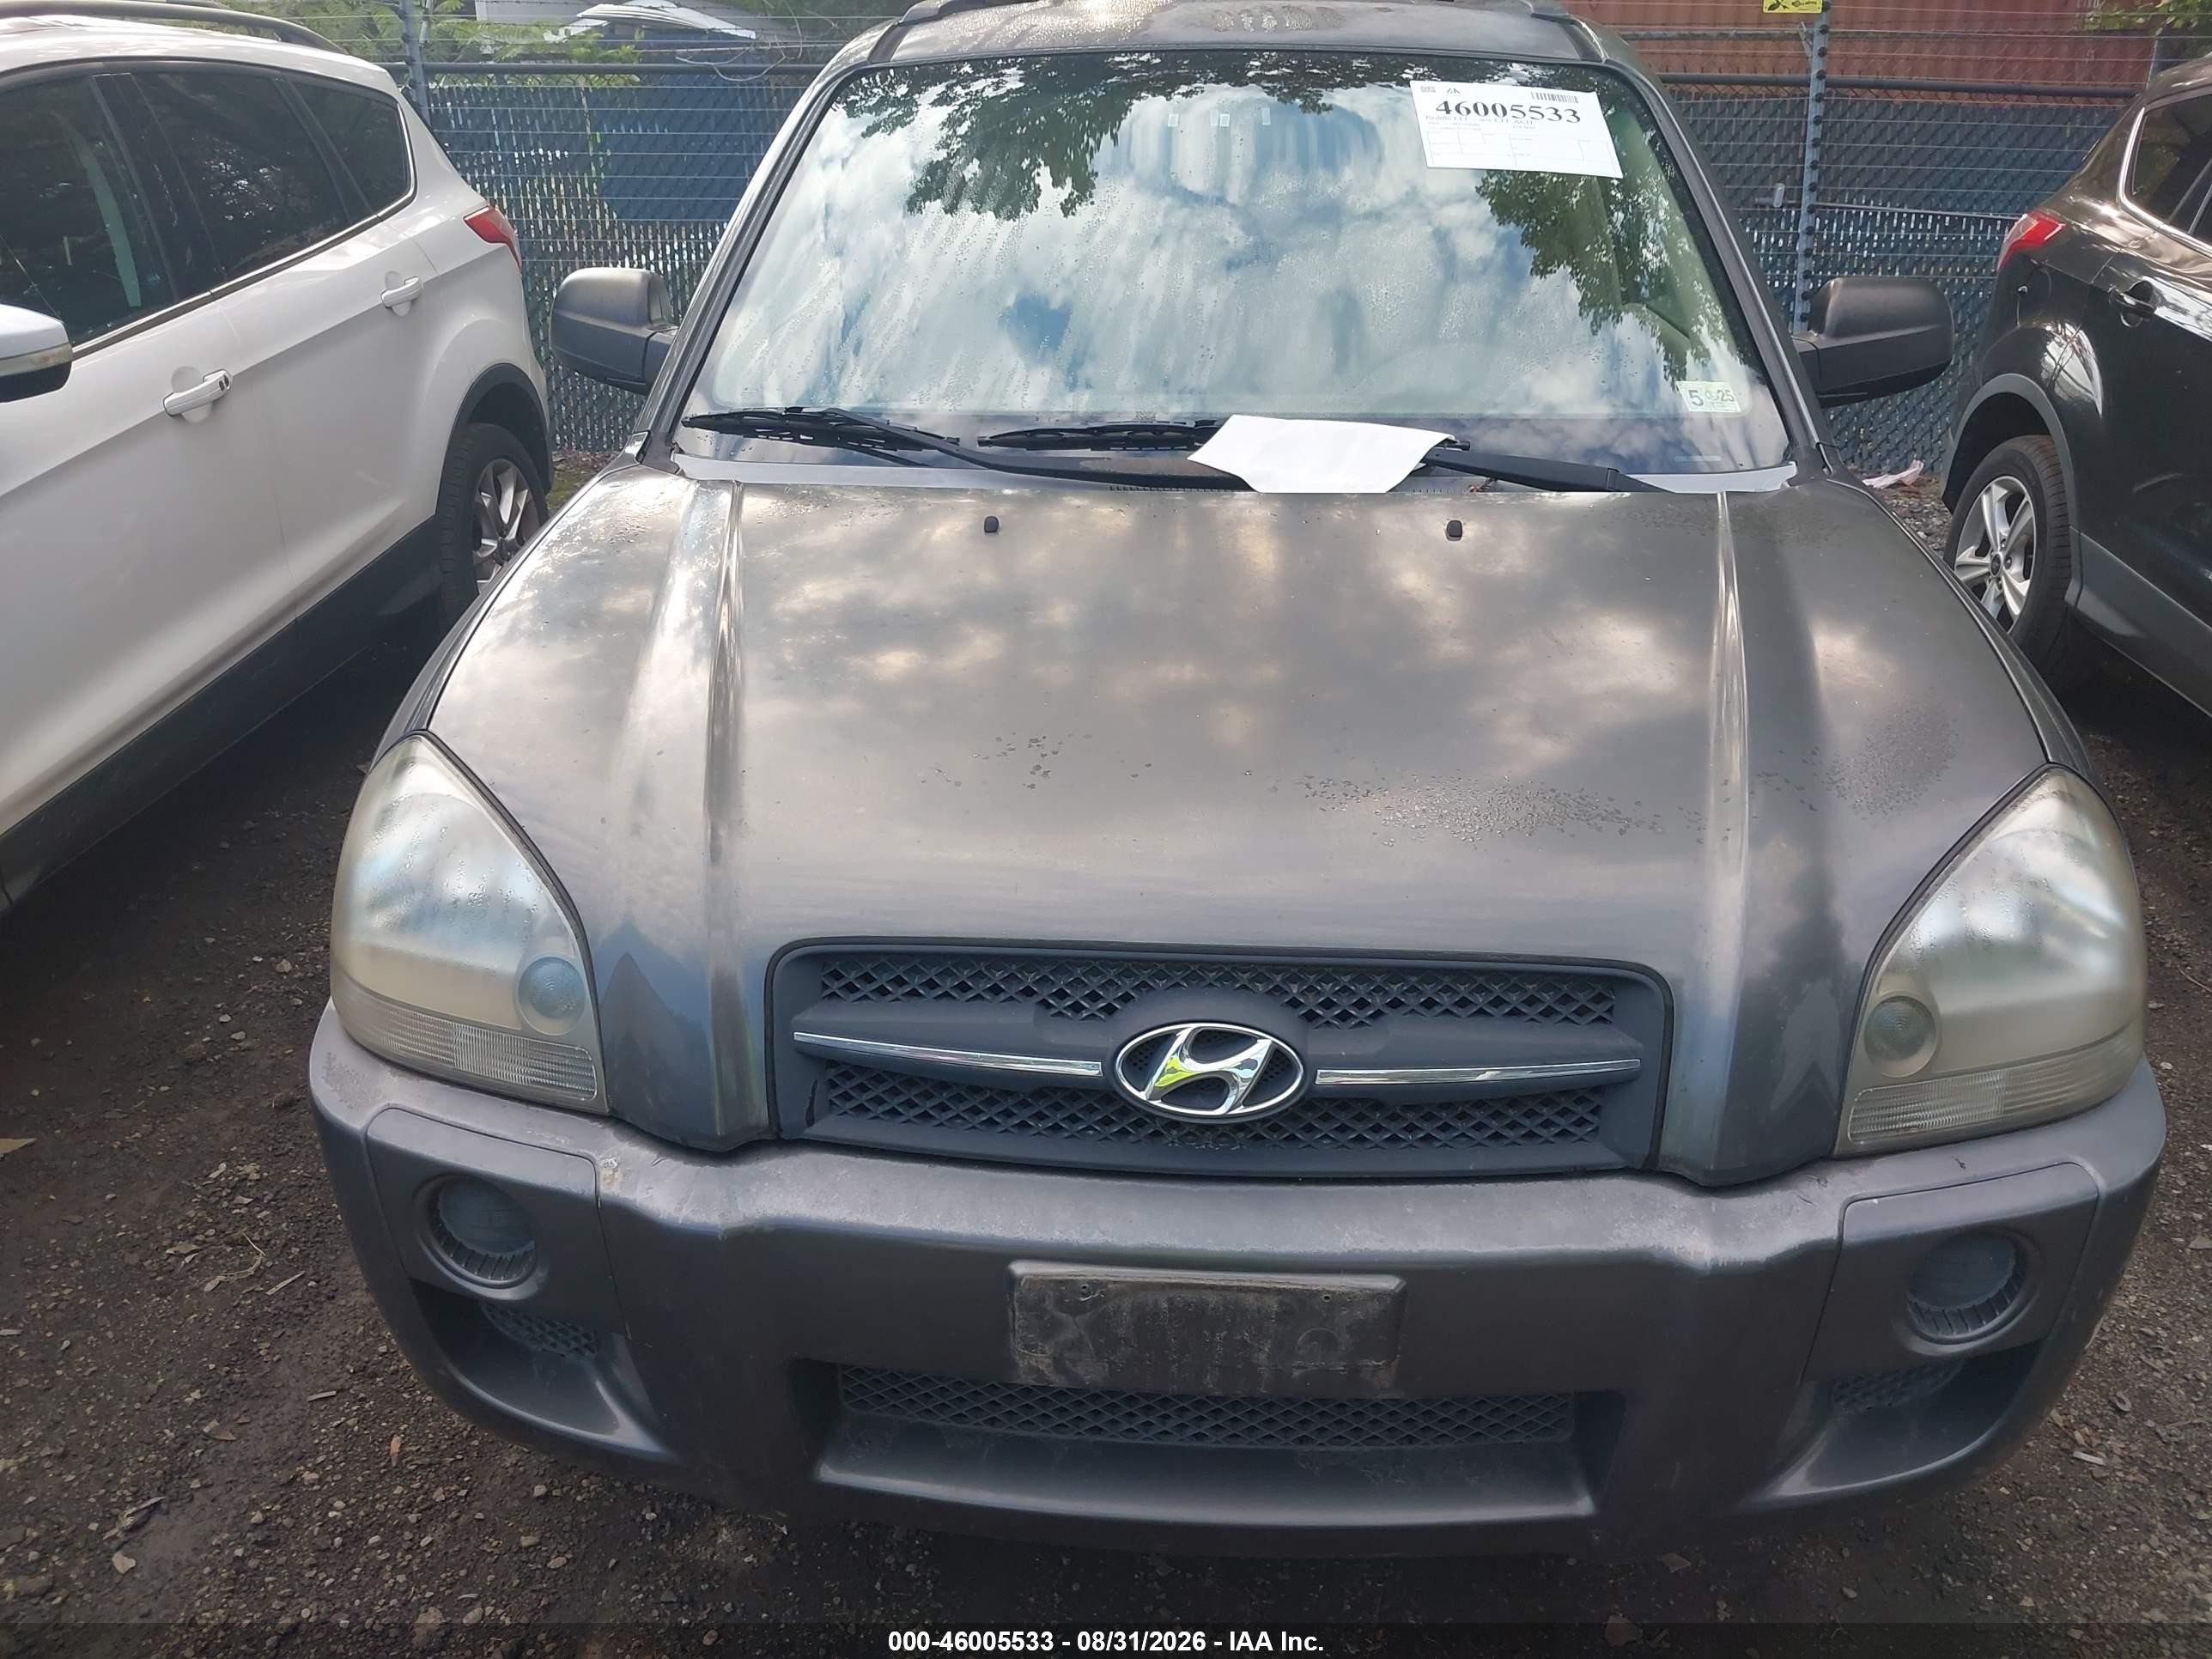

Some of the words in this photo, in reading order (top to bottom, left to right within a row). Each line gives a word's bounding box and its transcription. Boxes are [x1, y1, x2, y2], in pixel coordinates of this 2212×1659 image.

[1435, 100, 1582, 124] 46005533
[1688, 389, 1705, 406] 5
[1717, 389, 1735, 402] 25
